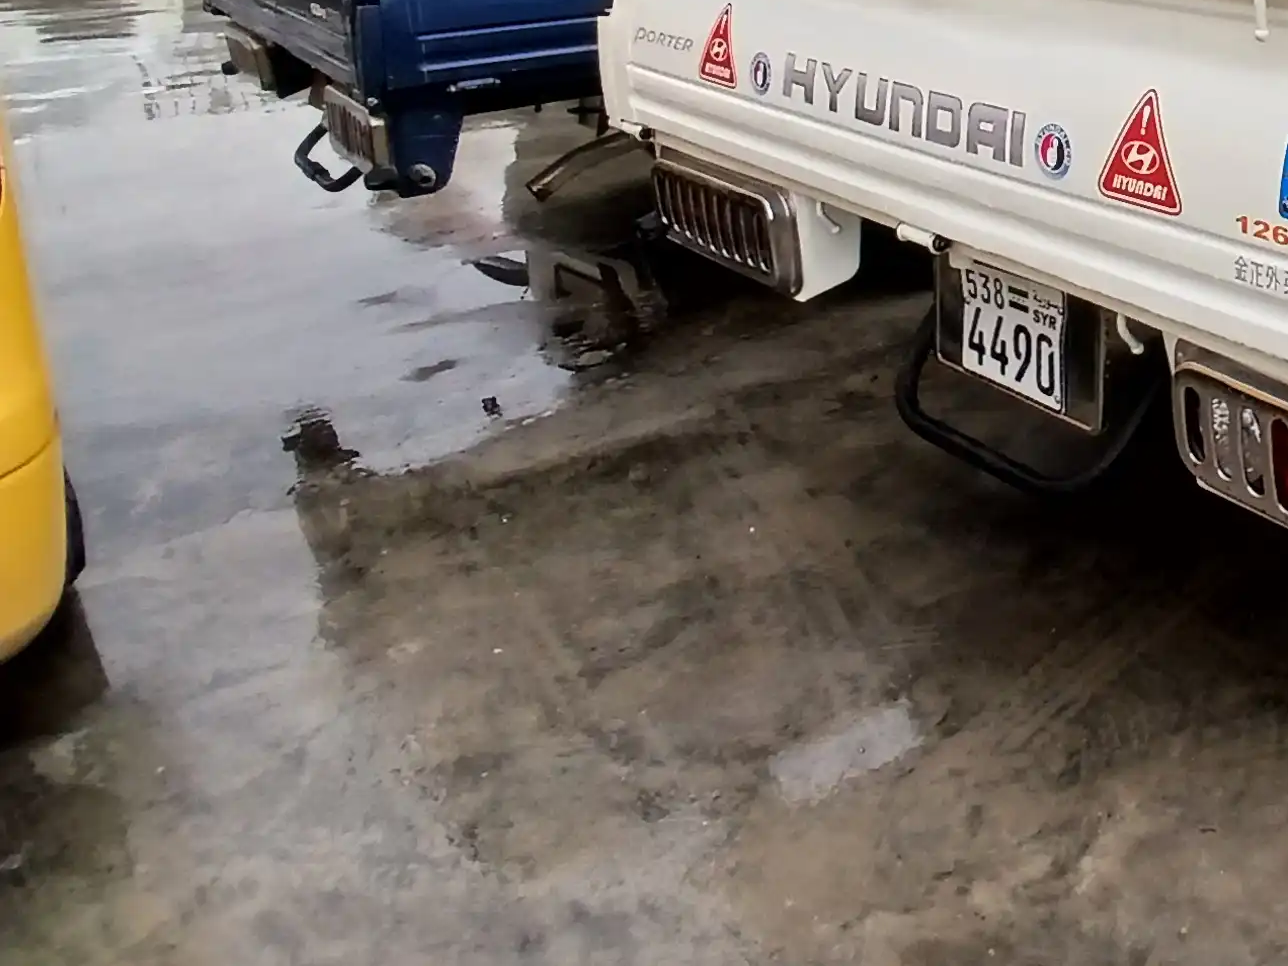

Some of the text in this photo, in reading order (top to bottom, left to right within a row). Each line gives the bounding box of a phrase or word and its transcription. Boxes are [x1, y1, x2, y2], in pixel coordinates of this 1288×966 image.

[634, 26, 694, 52] PORTER
[782, 51, 1027, 168] HYUNDAI
[1112, 173, 1168, 201] HYUNDAI
[965, 268, 1005, 310] 538
[1032, 309, 1057, 331] SYR
[968, 306, 1056, 397] 4490
